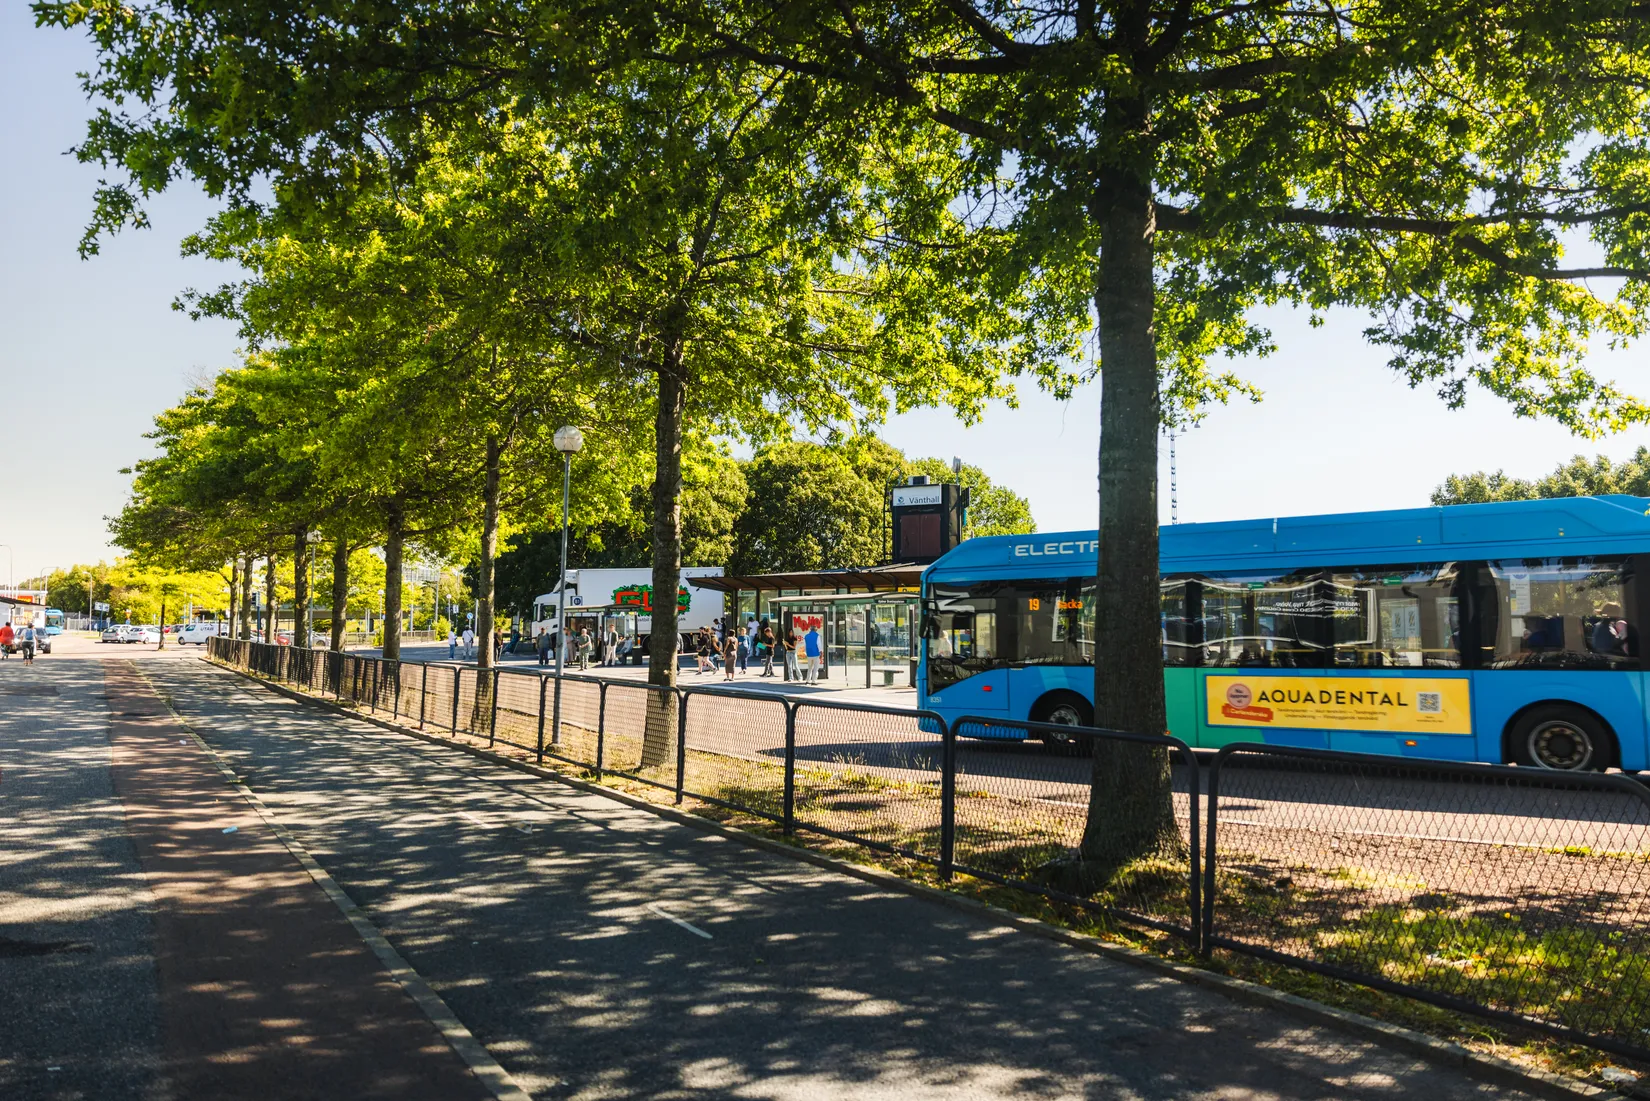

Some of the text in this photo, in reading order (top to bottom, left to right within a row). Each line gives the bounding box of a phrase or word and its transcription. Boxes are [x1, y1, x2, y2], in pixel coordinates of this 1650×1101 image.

[909, 496, 939, 504] Vänthall
[1015, 541, 1099, 556] ELECTR
[1028, 598, 1040, 611] 19
[1257, 689, 1408, 706] AQUADENTAL
